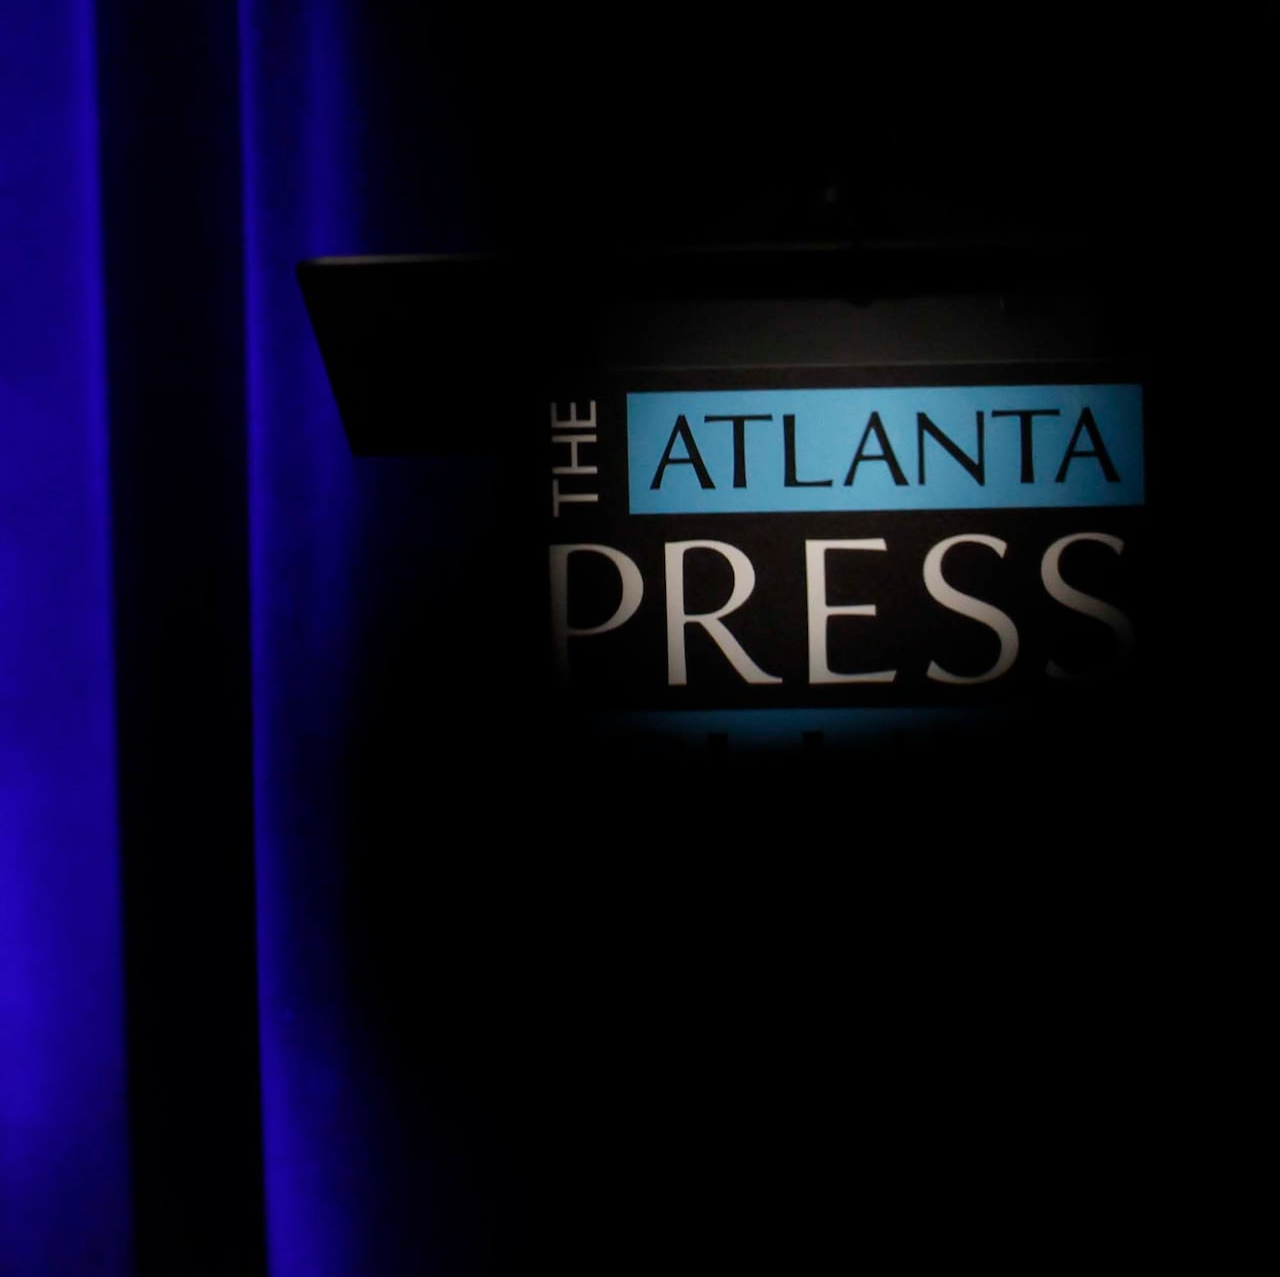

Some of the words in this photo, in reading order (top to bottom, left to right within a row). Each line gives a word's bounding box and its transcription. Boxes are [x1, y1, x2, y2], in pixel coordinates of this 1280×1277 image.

[549, 399, 599, 518] THE
[649, 406, 1122, 491] ATLANTA
[548, 531, 1136, 686] PRESS
